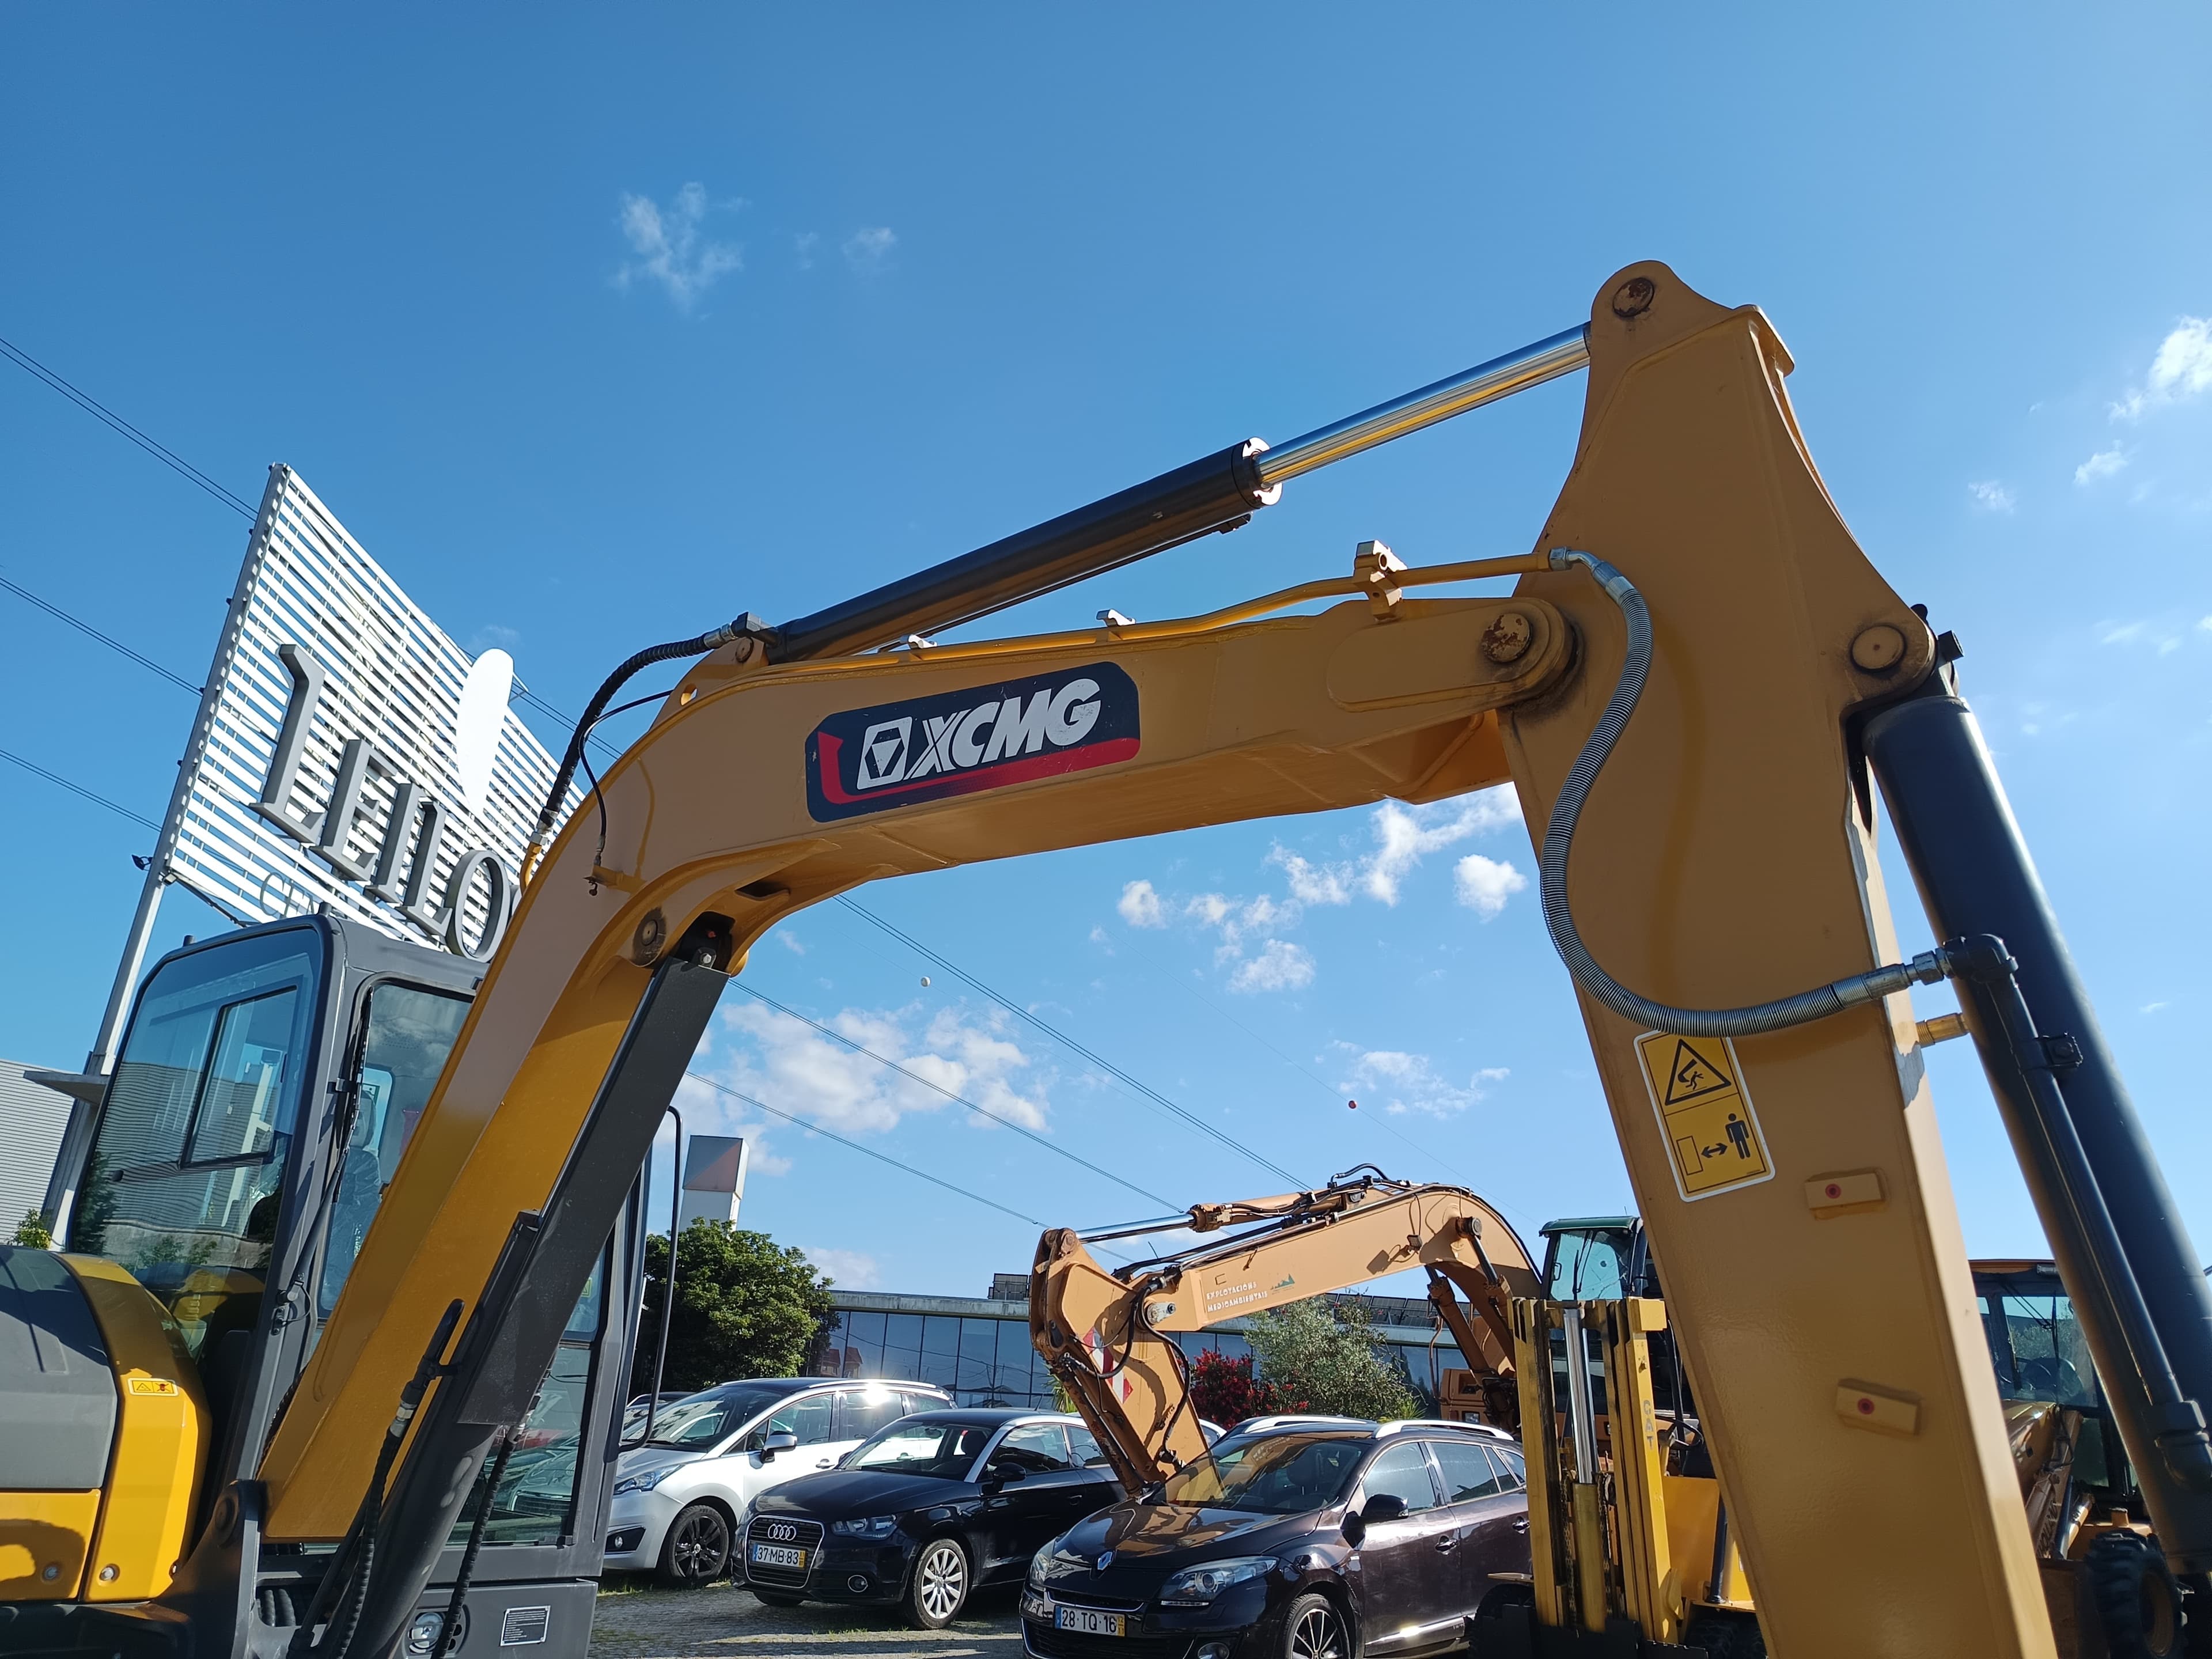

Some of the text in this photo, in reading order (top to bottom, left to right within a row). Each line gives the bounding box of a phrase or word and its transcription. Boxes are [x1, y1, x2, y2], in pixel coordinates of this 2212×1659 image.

[903, 678, 1101, 780] XCMG
[249, 644, 522, 963] LEILO
[1643, 1400, 1653, 1449] CAT
